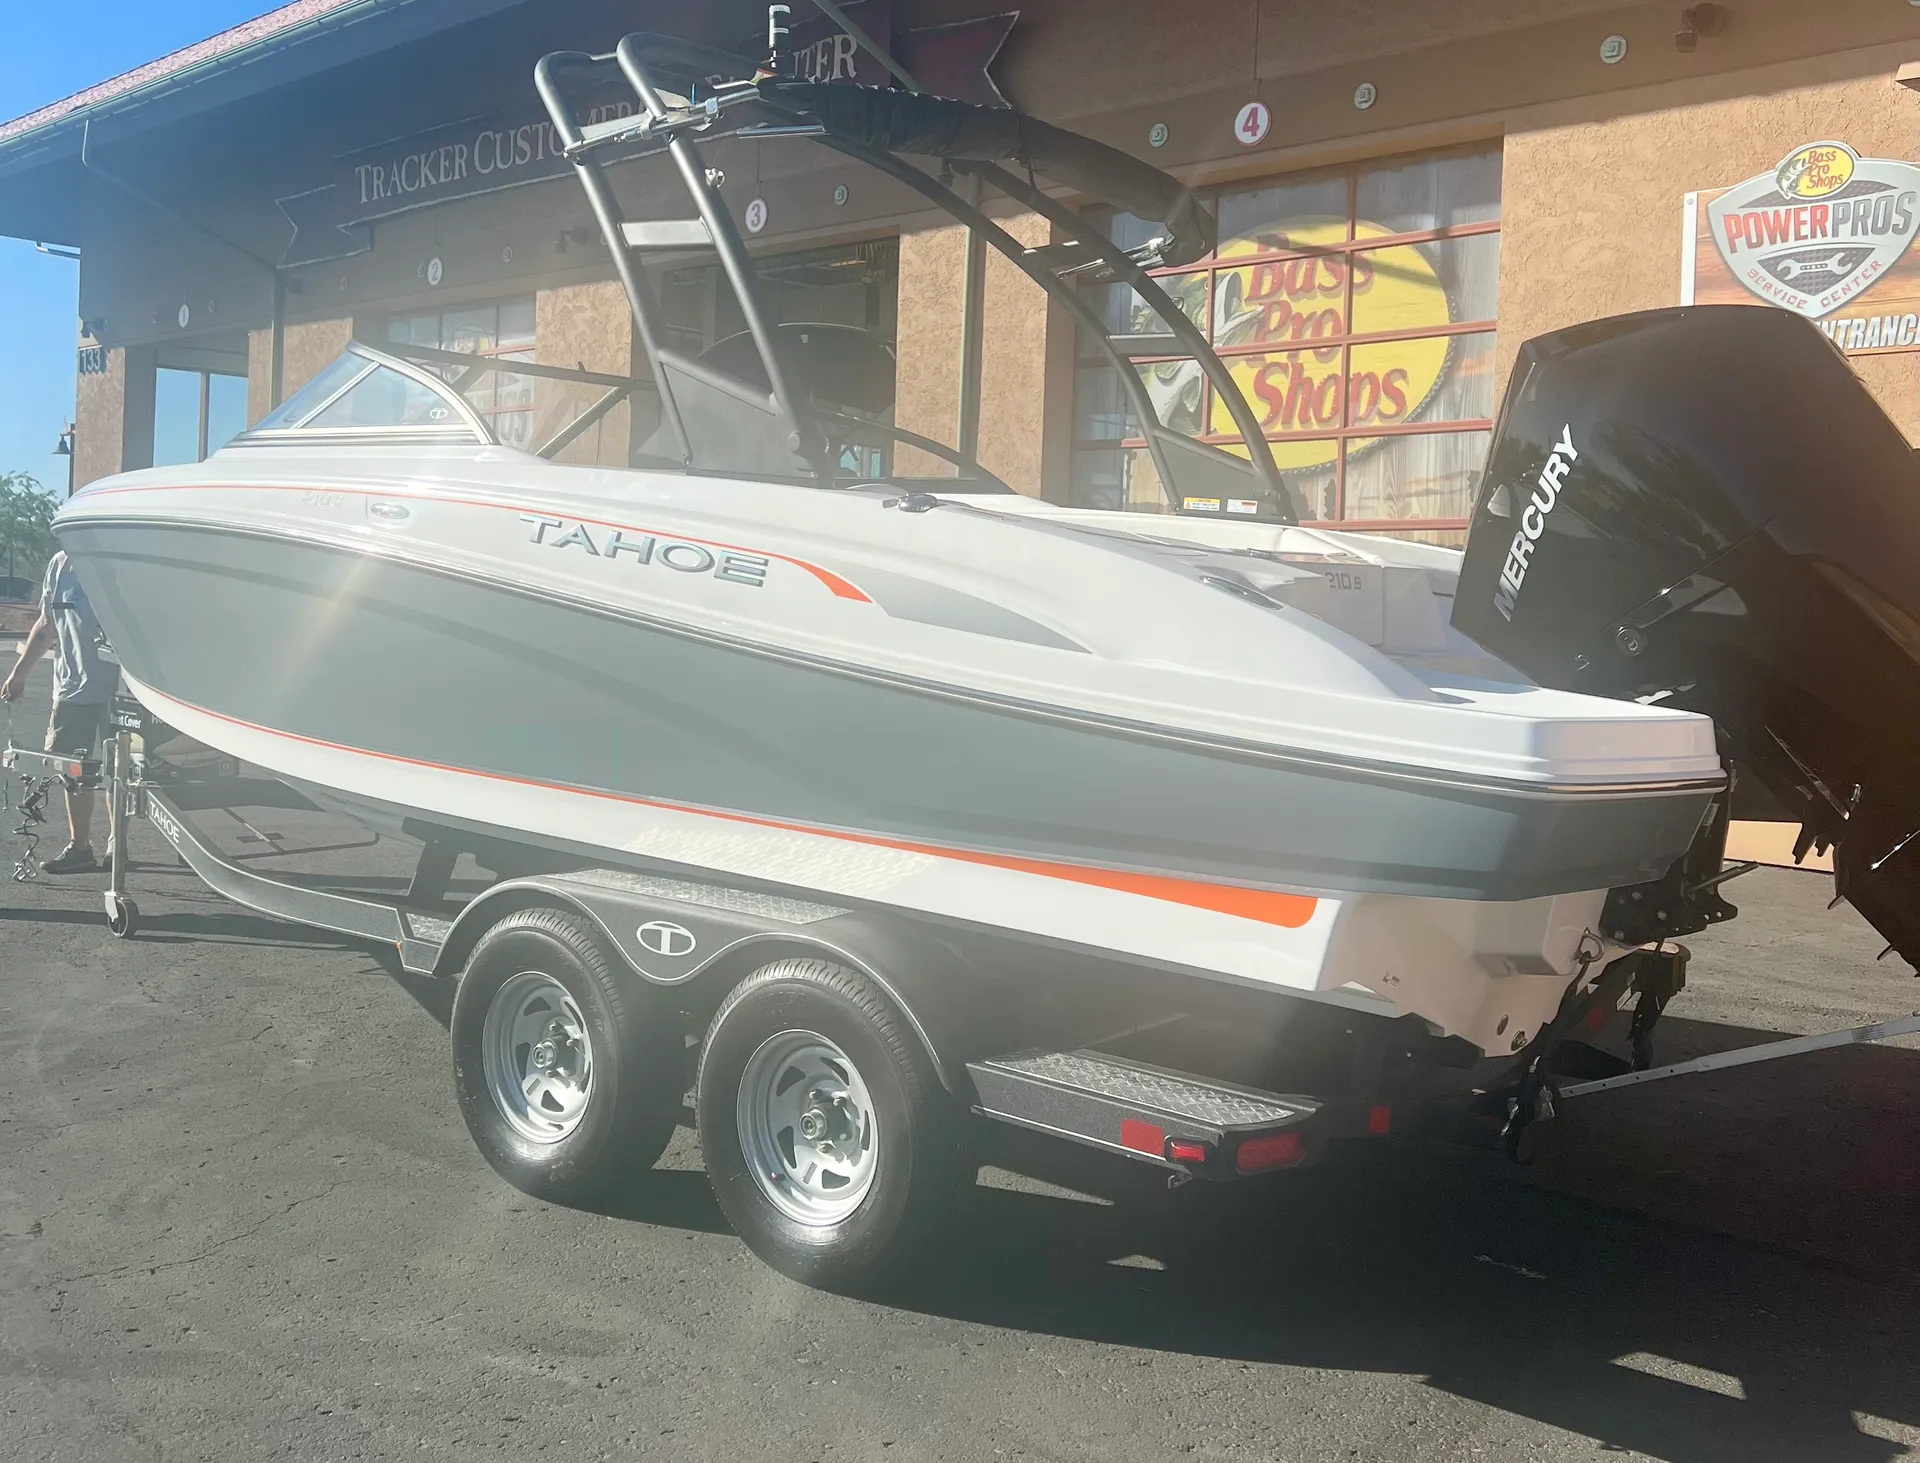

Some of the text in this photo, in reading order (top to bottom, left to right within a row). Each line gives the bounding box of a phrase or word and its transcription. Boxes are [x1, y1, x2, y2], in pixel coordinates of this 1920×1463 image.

[1241, 106, 1260, 136] 4
[354, 144, 470, 204] TRACKER
[1807, 163, 1830, 176] Pro
[1808, 150, 1837, 165] Bass
[1806, 173, 1845, 190] Shops
[750, 203, 762, 228] 3
[1722, 191, 1917, 255] POWERPROS
[1245, 231, 1378, 302] Bass
[1747, 259, 1884, 310] SERVICE CENTER
[1246, 300, 1343, 361] Pro
[1815, 313, 1920, 350] NTRANC
[81, 349, 101, 372] 133
[1253, 361, 1409, 427] Shops
[1493, 422, 1581, 622] MERCURY
[519, 512, 770, 588] TAHOE
[124, 714, 142, 730] Cover
[150, 800, 180, 844] TAHOE
